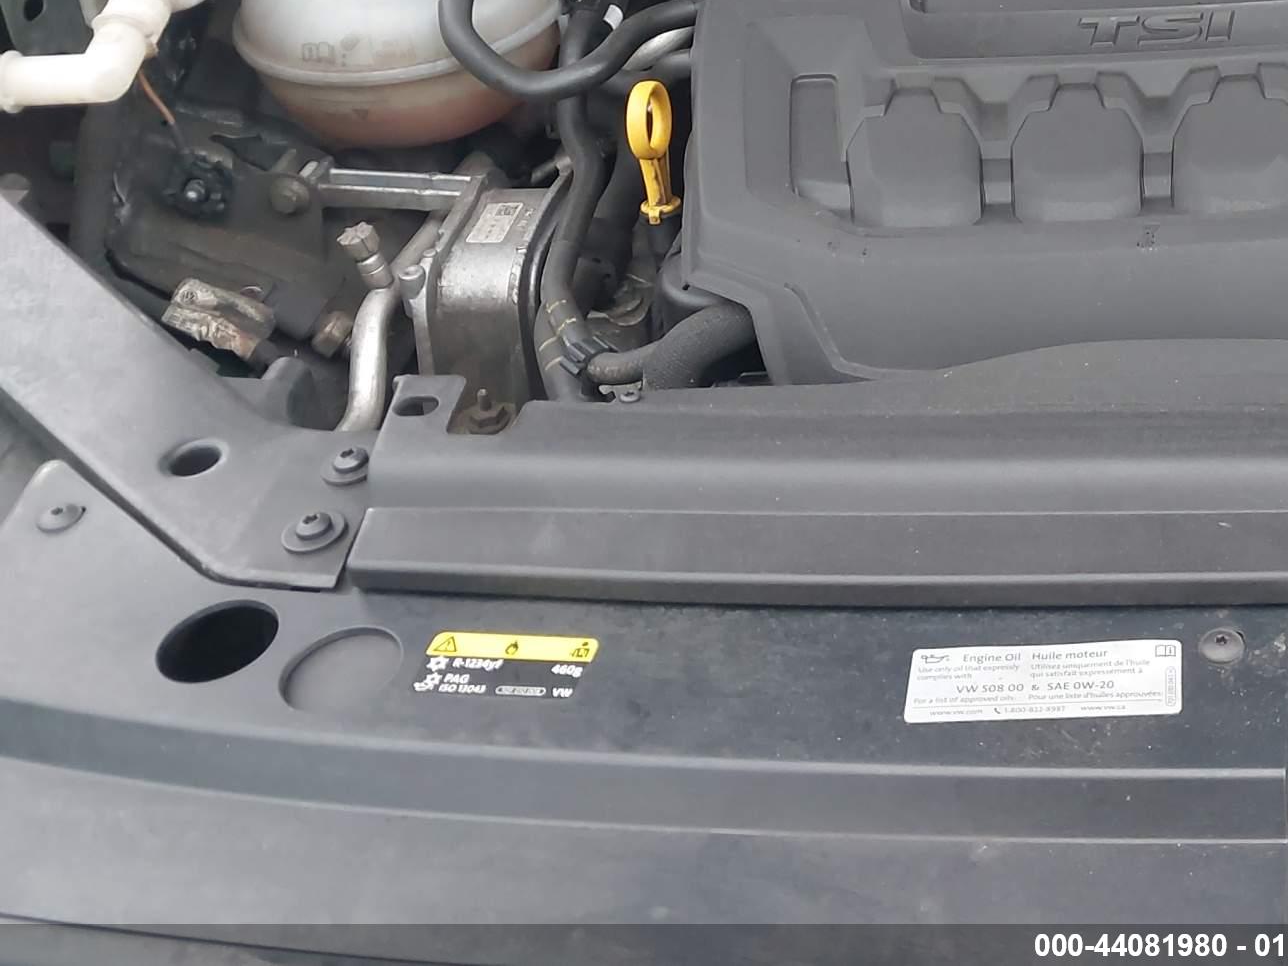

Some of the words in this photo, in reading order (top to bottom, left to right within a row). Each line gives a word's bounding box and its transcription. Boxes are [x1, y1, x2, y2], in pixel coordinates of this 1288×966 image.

[1079, 9, 1236, 48] TSI
[963, 653, 1001, 664] Engine
[1005, 653, 1021, 661] Oil
[1032, 651, 1062, 660] Huile
[1065, 650, 1107, 658] moteur
[452, 657, 503, 672] R-1234yf
[551, 665, 583, 677] 460g
[444, 673, 470, 683] PAG
[439, 683, 457, 692] ISO
[956, 684, 978, 693] VW
[981, 683, 1004, 692] 508
[1008, 683, 1023, 691] 00
[1031, 682, 1039, 690] &
[1047, 681, 1070, 690] SAE
[1073, 680, 1114, 689] 0W-20
[552, 688, 573, 698] VW
